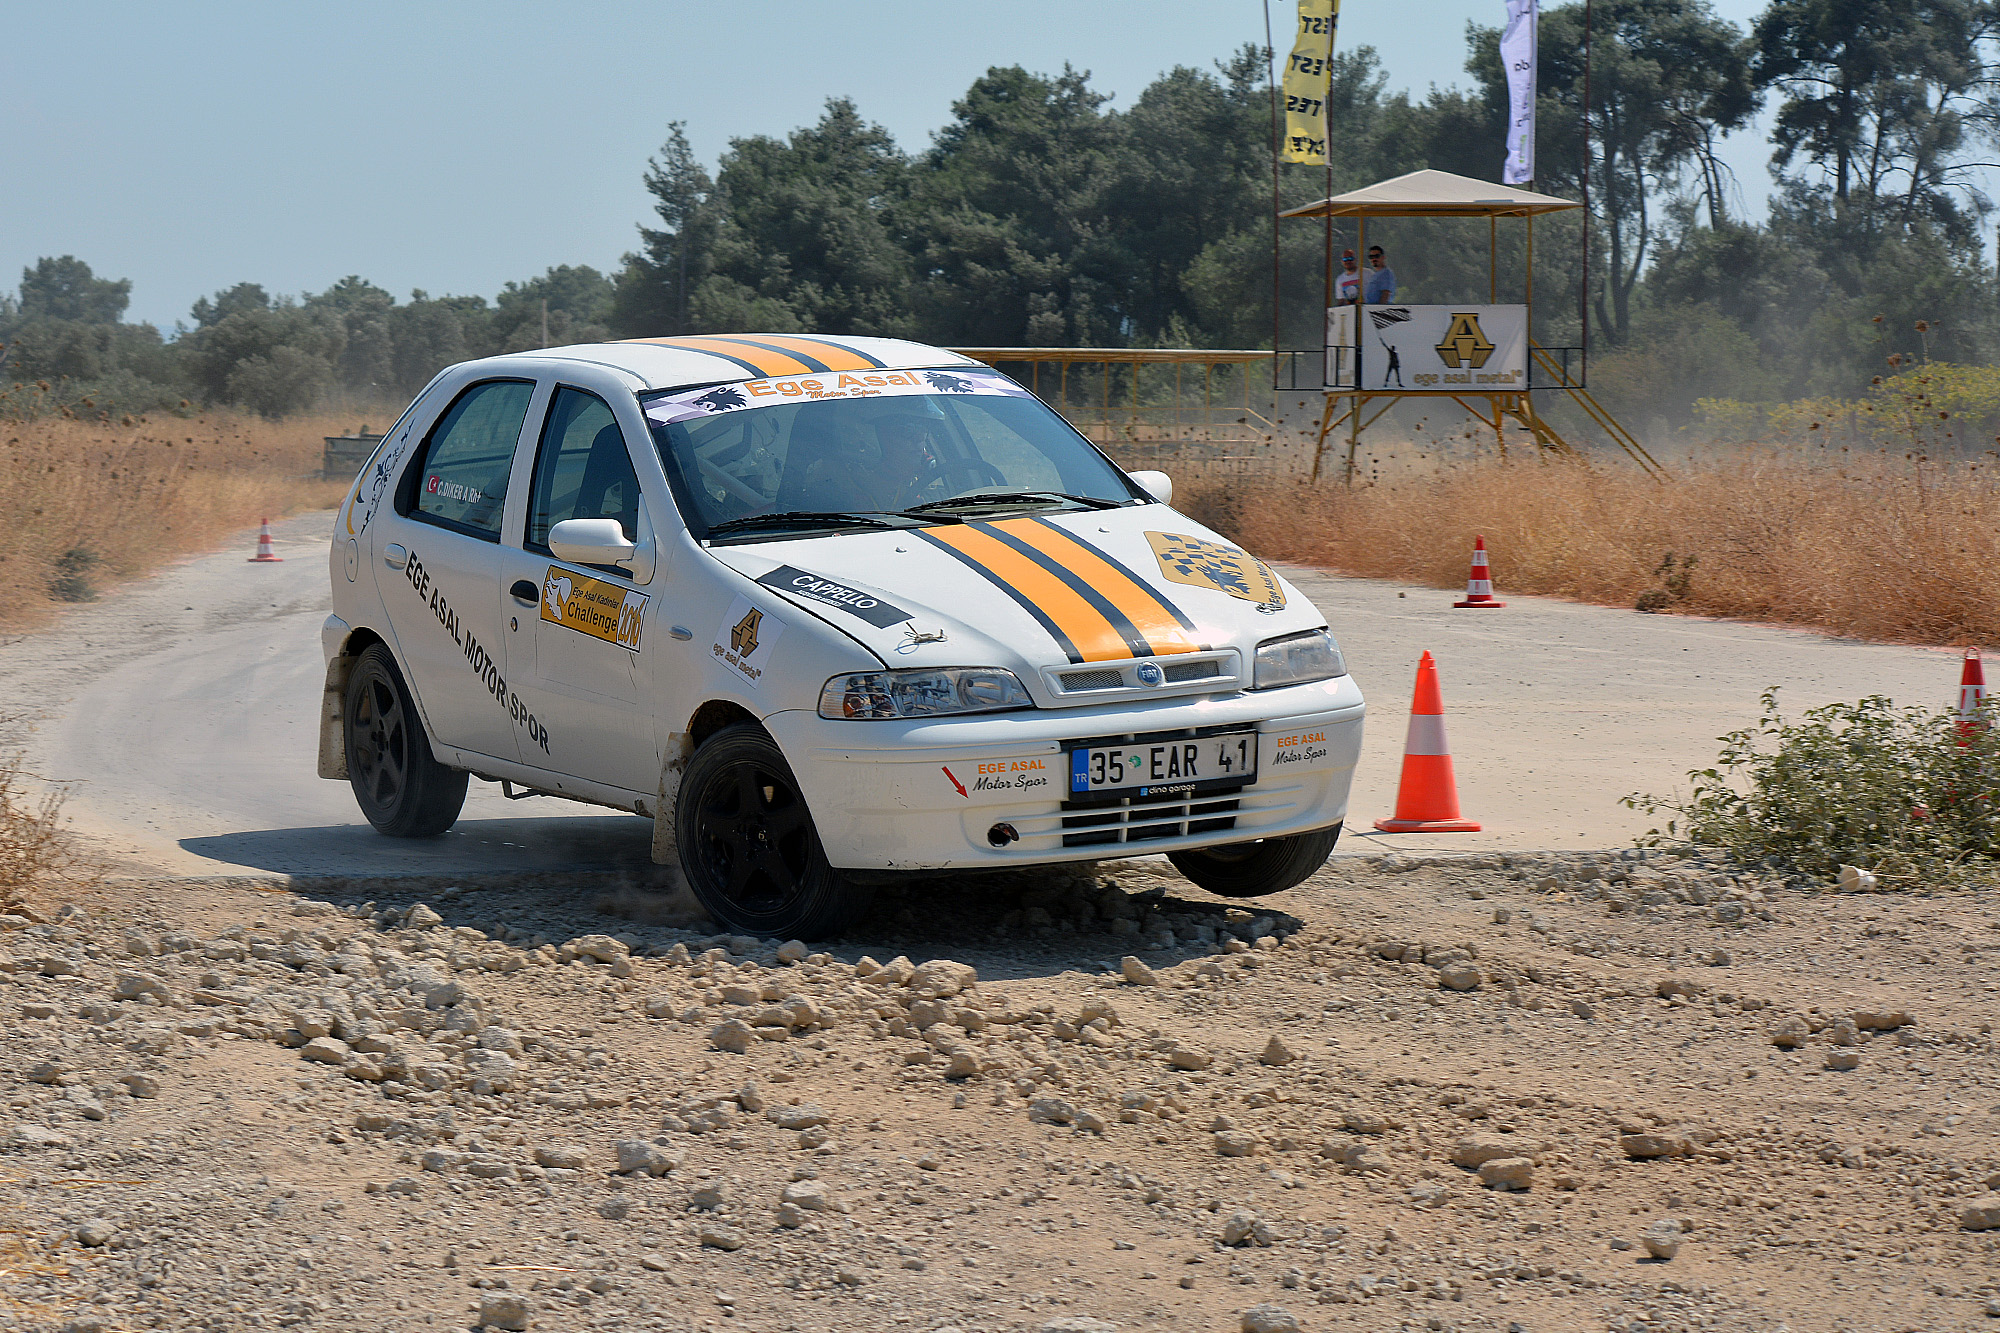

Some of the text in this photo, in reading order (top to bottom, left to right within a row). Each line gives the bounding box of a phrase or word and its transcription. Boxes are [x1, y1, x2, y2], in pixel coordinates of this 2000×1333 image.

[744, 372, 922, 397] Ege Asal
[1414, 372, 1438, 386] ege
[1443, 370, 1471, 384] asal
[806, 388, 881, 399] Motor Spor
[462, 486, 468, 501] A
[572, 587, 584, 599] Ege
[583, 590, 598, 601] Asal
[792, 575, 878, 609] CAPPELLO
[567, 601, 617, 634] Challenge
[405, 551, 551, 756] EGE ASAL MOTOR SPOR
[713, 643, 725, 656] ege
[724, 651, 741, 666] asal
[1141, 669, 1157, 679] FIAT
[1277, 732, 1326, 748] EGE ASAL
[1272, 746, 1327, 765] Motor Spor
[978, 759, 1046, 774] EGE ASAL
[1075, 773, 1087, 783] TR
[1090, 751, 1123, 785] 35
[1150, 744, 1198, 780] EAR
[972, 774, 1048, 792] Motor Spor
[1149, 783, 1196, 794] dino garage
